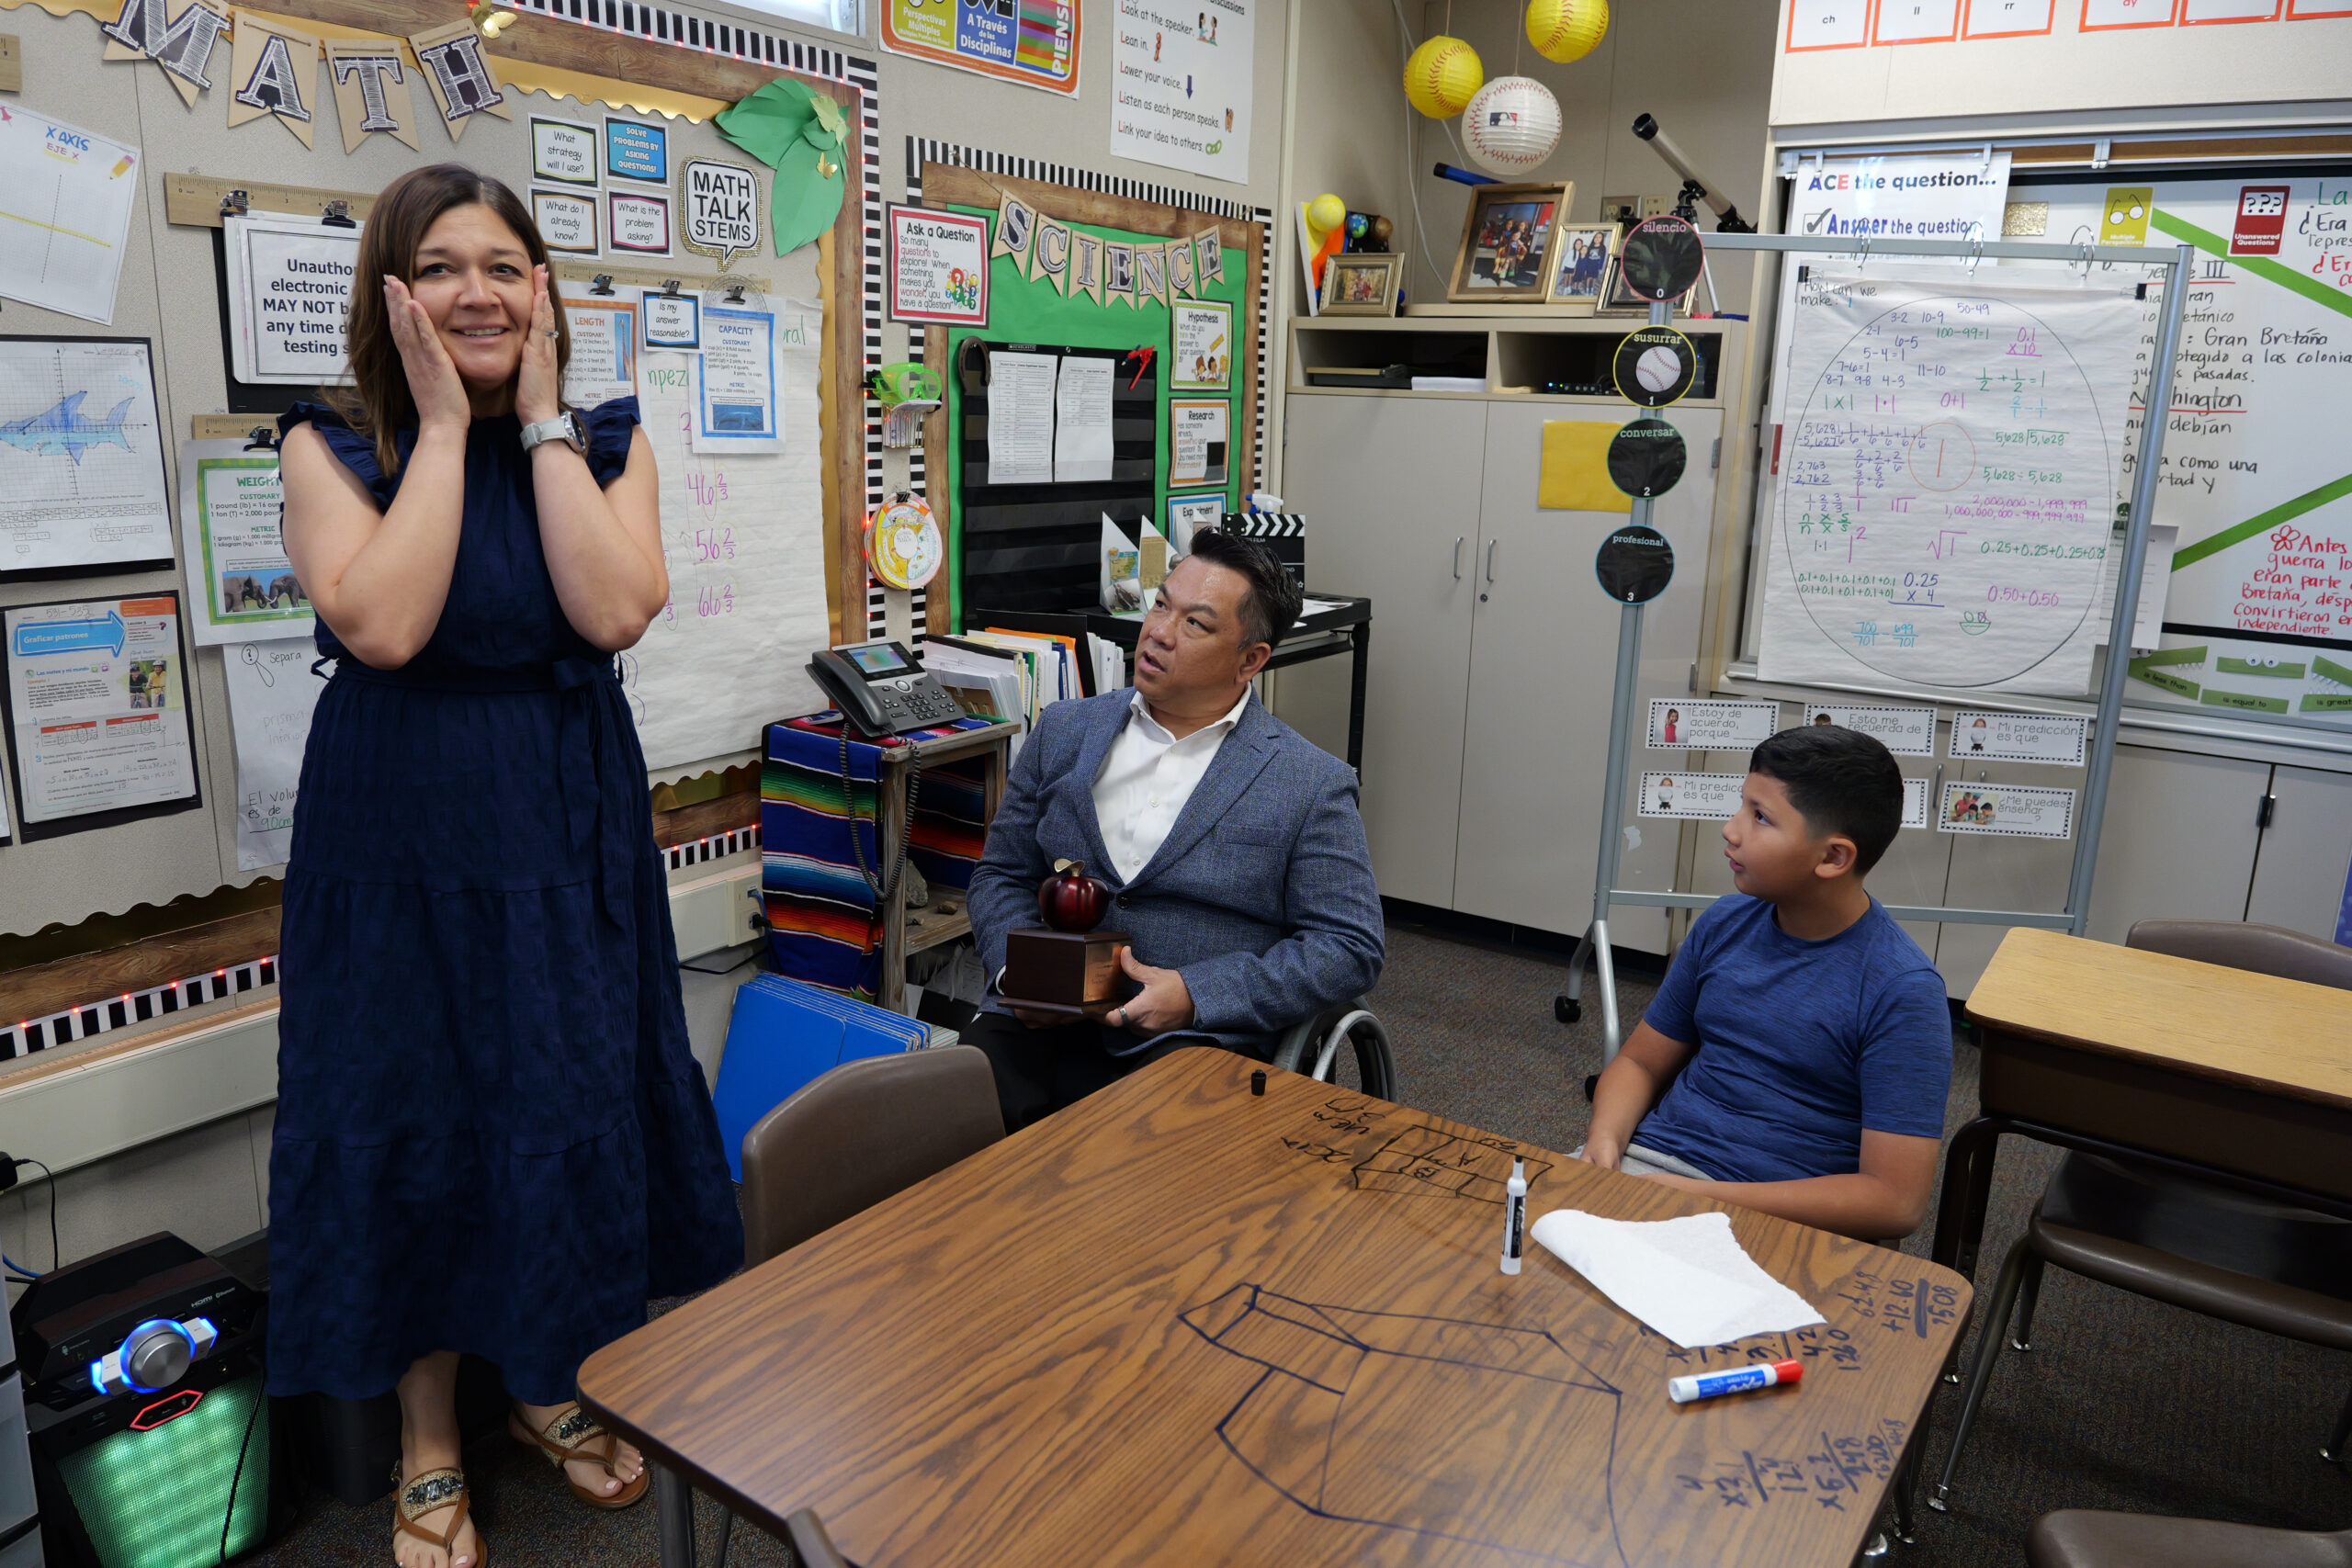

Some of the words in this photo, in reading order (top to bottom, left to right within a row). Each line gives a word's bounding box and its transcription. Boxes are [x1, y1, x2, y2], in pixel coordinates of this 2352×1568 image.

[2004, 2, 2015, 10] rr
[903, 6, 947, 27] Perspectivas
[1121, 1, 1139, 18] Look
[1141, 10, 1148, 20] at
[1151, 12, 1163, 26] the
[1165, 18, 1194, 37] speaker.
[1822, 15, 1836, 24] ch
[908, 19, 941, 37] Múltiples
[967, 13, 974, 25] A
[976, 14, 1008, 34] Través
[1120, 30, 1138, 48] Lean
[960, 34, 1012, 59] Disciplinas
[101, 0, 503, 133] MATH
[1120, 61, 1143, 78] Lower
[1145, 72, 1160, 84] your
[1162, 76, 1182, 90] voice.
[1119, 91, 1142, 108] Listen
[1144, 101, 1152, 111] as
[1154, 103, 1170, 116] each
[1172, 108, 1195, 122] person
[1197, 114, 1220, 129] speaks.
[59, 131, 90, 152] AXIS
[554, 130, 575, 143] What
[1118, 119, 1135, 135] Link
[1136, 127, 1151, 140] your
[1154, 130, 1169, 143] idea
[1170, 135, 1178, 146] to
[1180, 138, 1204, 152] others.
[46, 142, 67, 155] EJE
[548, 146, 582, 161] strategy
[547, 161, 560, 170] will
[567, 164, 584, 174] use?
[694, 171, 750, 198] MATH
[1808, 174, 1849, 191] ACE
[1855, 174, 1885, 189] the
[1892, 171, 1996, 191] question...
[2317, 181, 2348, 206] La
[546, 200, 568, 211] What
[571, 204, 579, 213] do
[618, 202, 638, 213] What
[648, 207, 661, 216] the
[695, 195, 751, 222] TALK
[551, 216, 581, 230] already
[626, 219, 654, 229] problem
[1642, 221, 1687, 232] silencio
[1826, 213, 1888, 235] Answer
[1890, 218, 1913, 233] the
[1917, 218, 1975, 237] question
[555, 231, 578, 242] know?
[628, 232, 653, 243] asking?
[695, 220, 751, 242] STEMS
[907, 222, 924, 235] Ask
[936, 226, 975, 243] Question
[2233, 232, 2280, 242] Unanswered
[910, 238, 929, 250] many
[1001, 199, 1223, 296] SCIENCE
[2236, 239, 2276, 247] Questions
[900, 246, 932, 258] questions
[900, 257, 927, 269] explore!
[932, 260, 950, 269] When
[900, 267, 933, 278] something
[271, 278, 348, 296] electronic
[899, 277, 922, 287] makes
[900, 288, 927, 299] wonder,
[1657, 288, 1664, 298] 0
[1832, 285, 1853, 297] can
[1860, 286, 1878, 297] we
[263, 299, 297, 312] MAY
[303, 300, 335, 314] NOT
[667, 304, 677, 313] my
[899, 299, 916, 307] have
[1957, 302, 1990, 315] 50-49
[574, 317, 605, 326] LENGTH
[656, 316, 681, 324] answer
[1188, 311, 1218, 324] Hypothesis
[266, 321, 295, 336] any
[300, 320, 334, 334] time
[650, 329, 690, 338] reasonable?
[718, 325, 753, 335] CAPACITY
[1634, 332, 1682, 344] susurrar
[2204, 327, 2247, 347] Gran
[284, 339, 338, 356] testing
[2264, 349, 2287, 364] las
[2193, 368, 2256, 384] pasadas.
[1189, 410, 1215, 421] Research
[1620, 426, 1676, 439] conversar
[2179, 456, 2220, 469] como
[2229, 458, 2257, 473] una
[1644, 486, 1651, 496] 2
[695, 528, 720, 562] 56
[1612, 534, 1664, 547] profesional
[2298, 535, 2347, 555] Antes
[2267, 551, 2324, 573] guerra
[1904, 571, 1939, 588] 0.25
[2253, 568, 2292, 584] eran
[2301, 574, 2342, 591] parte
[698, 585, 721, 617] 66
[1627, 592, 1634, 602] 3
[24, 634, 54, 645] Graficar
[54, 631, 89, 643] patrones
[269, 651, 302, 667] Separa
[2153, 674, 2167, 685] less
[2170, 677, 2188, 691] than
[2232, 698, 2256, 707] equal
[1691, 706, 1724, 718] Estoy
[1728, 709, 1742, 718] de
[1690, 718, 1739, 729] acuerdo,
[1849, 714, 1878, 726] Esto
[1882, 716, 1899, 725] me
[1689, 728, 1730, 739] porque
[1848, 722, 1904, 734] recuerda
[1906, 725, 1922, 735] de
[1997, 721, 2011, 732] Mi
[2014, 722, 2078, 736] predicción
[1996, 732, 2011, 741] es
[2015, 734, 2040, 745] que
[1684, 780, 1696, 791] Mi
[248, 791, 264, 807] El
[1683, 791, 1698, 800] es
[1702, 792, 1724, 803] que
[1998, 795, 2022, 807] ¿Me
[2025, 797, 2066, 810] puedes
[248, 809, 261, 819] es
[268, 805, 281, 816] de
[1997, 804, 2043, 816] enseñar
[190, 1294, 214, 1308] HDMI
